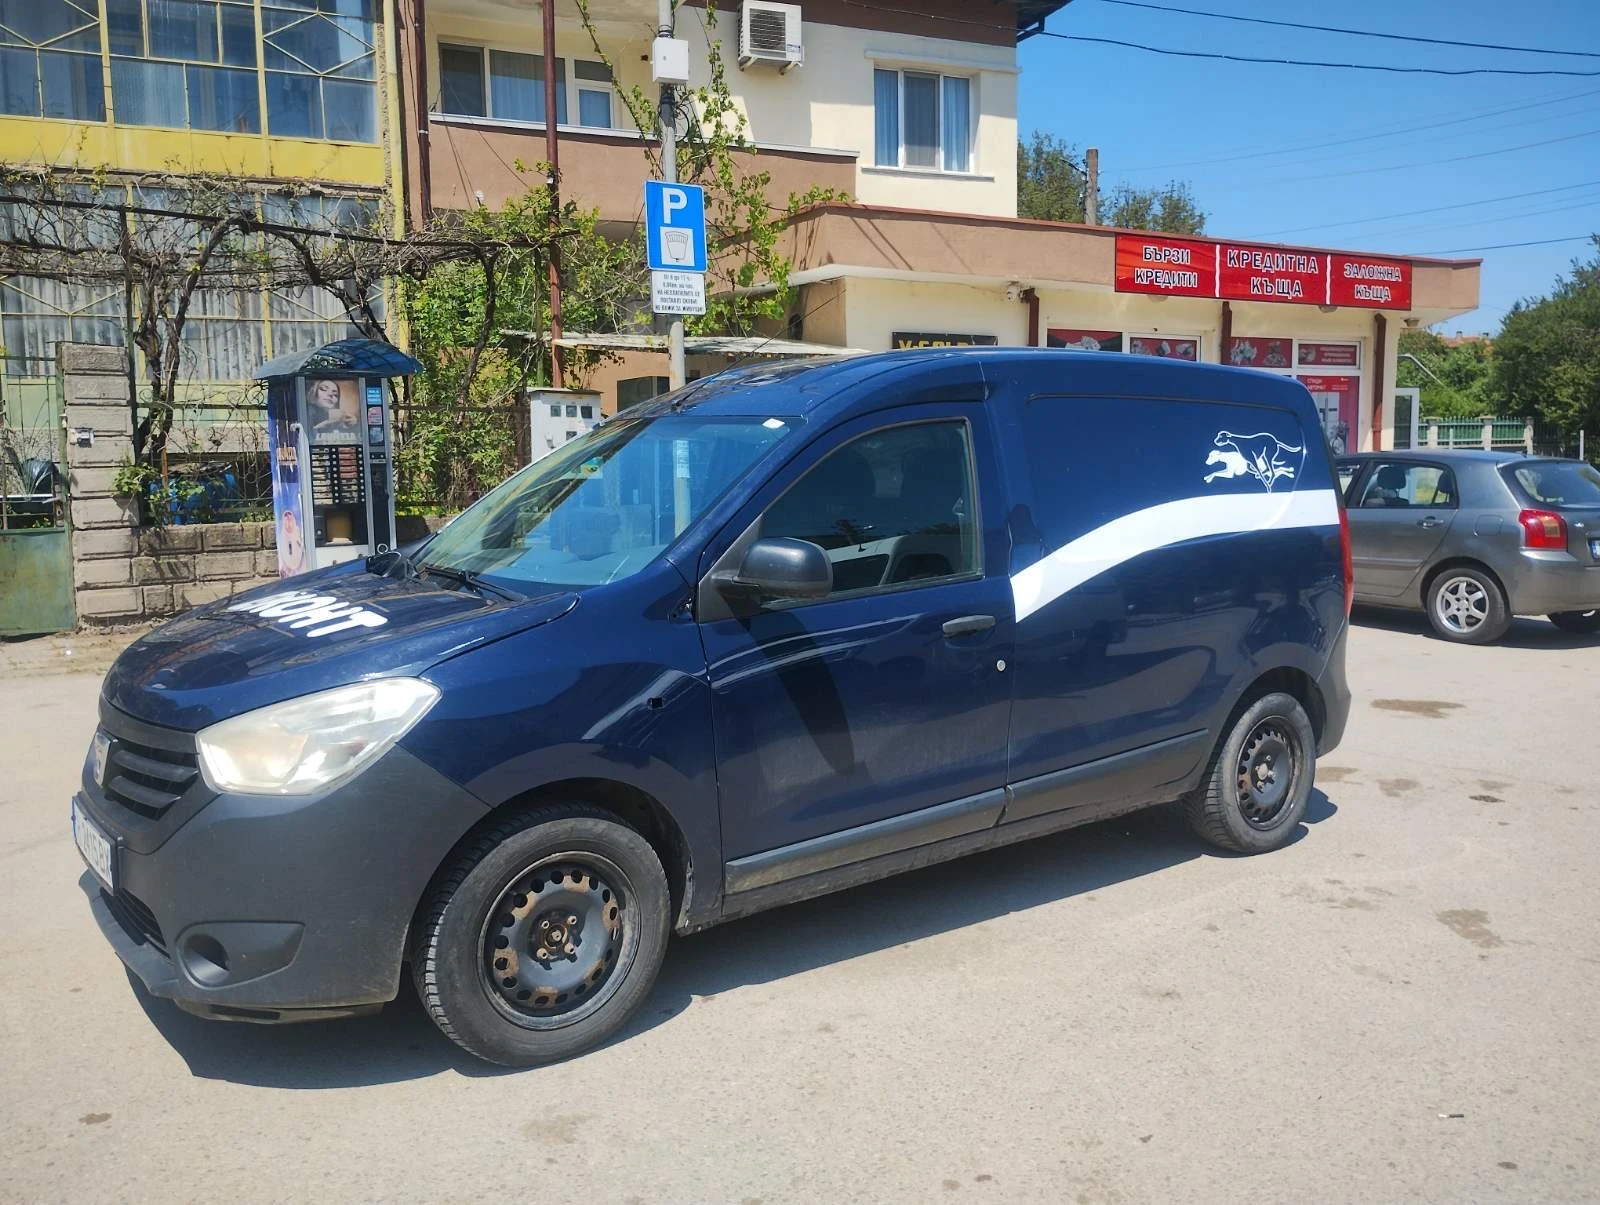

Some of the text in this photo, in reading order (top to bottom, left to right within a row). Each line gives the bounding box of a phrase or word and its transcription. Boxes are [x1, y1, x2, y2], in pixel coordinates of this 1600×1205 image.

[662, 187, 688, 225] P
[1143, 245, 1191, 265] БЪРЗИ
[1227, 249, 1319, 274] КРЕДИТНА
[1134, 267, 1198, 289] КРЕДИТИ
[1343, 262, 1402, 282] ЗАЛОЖНА
[1251, 276, 1303, 299] КЪЩА
[1354, 284, 1392, 303] КЪЩА
